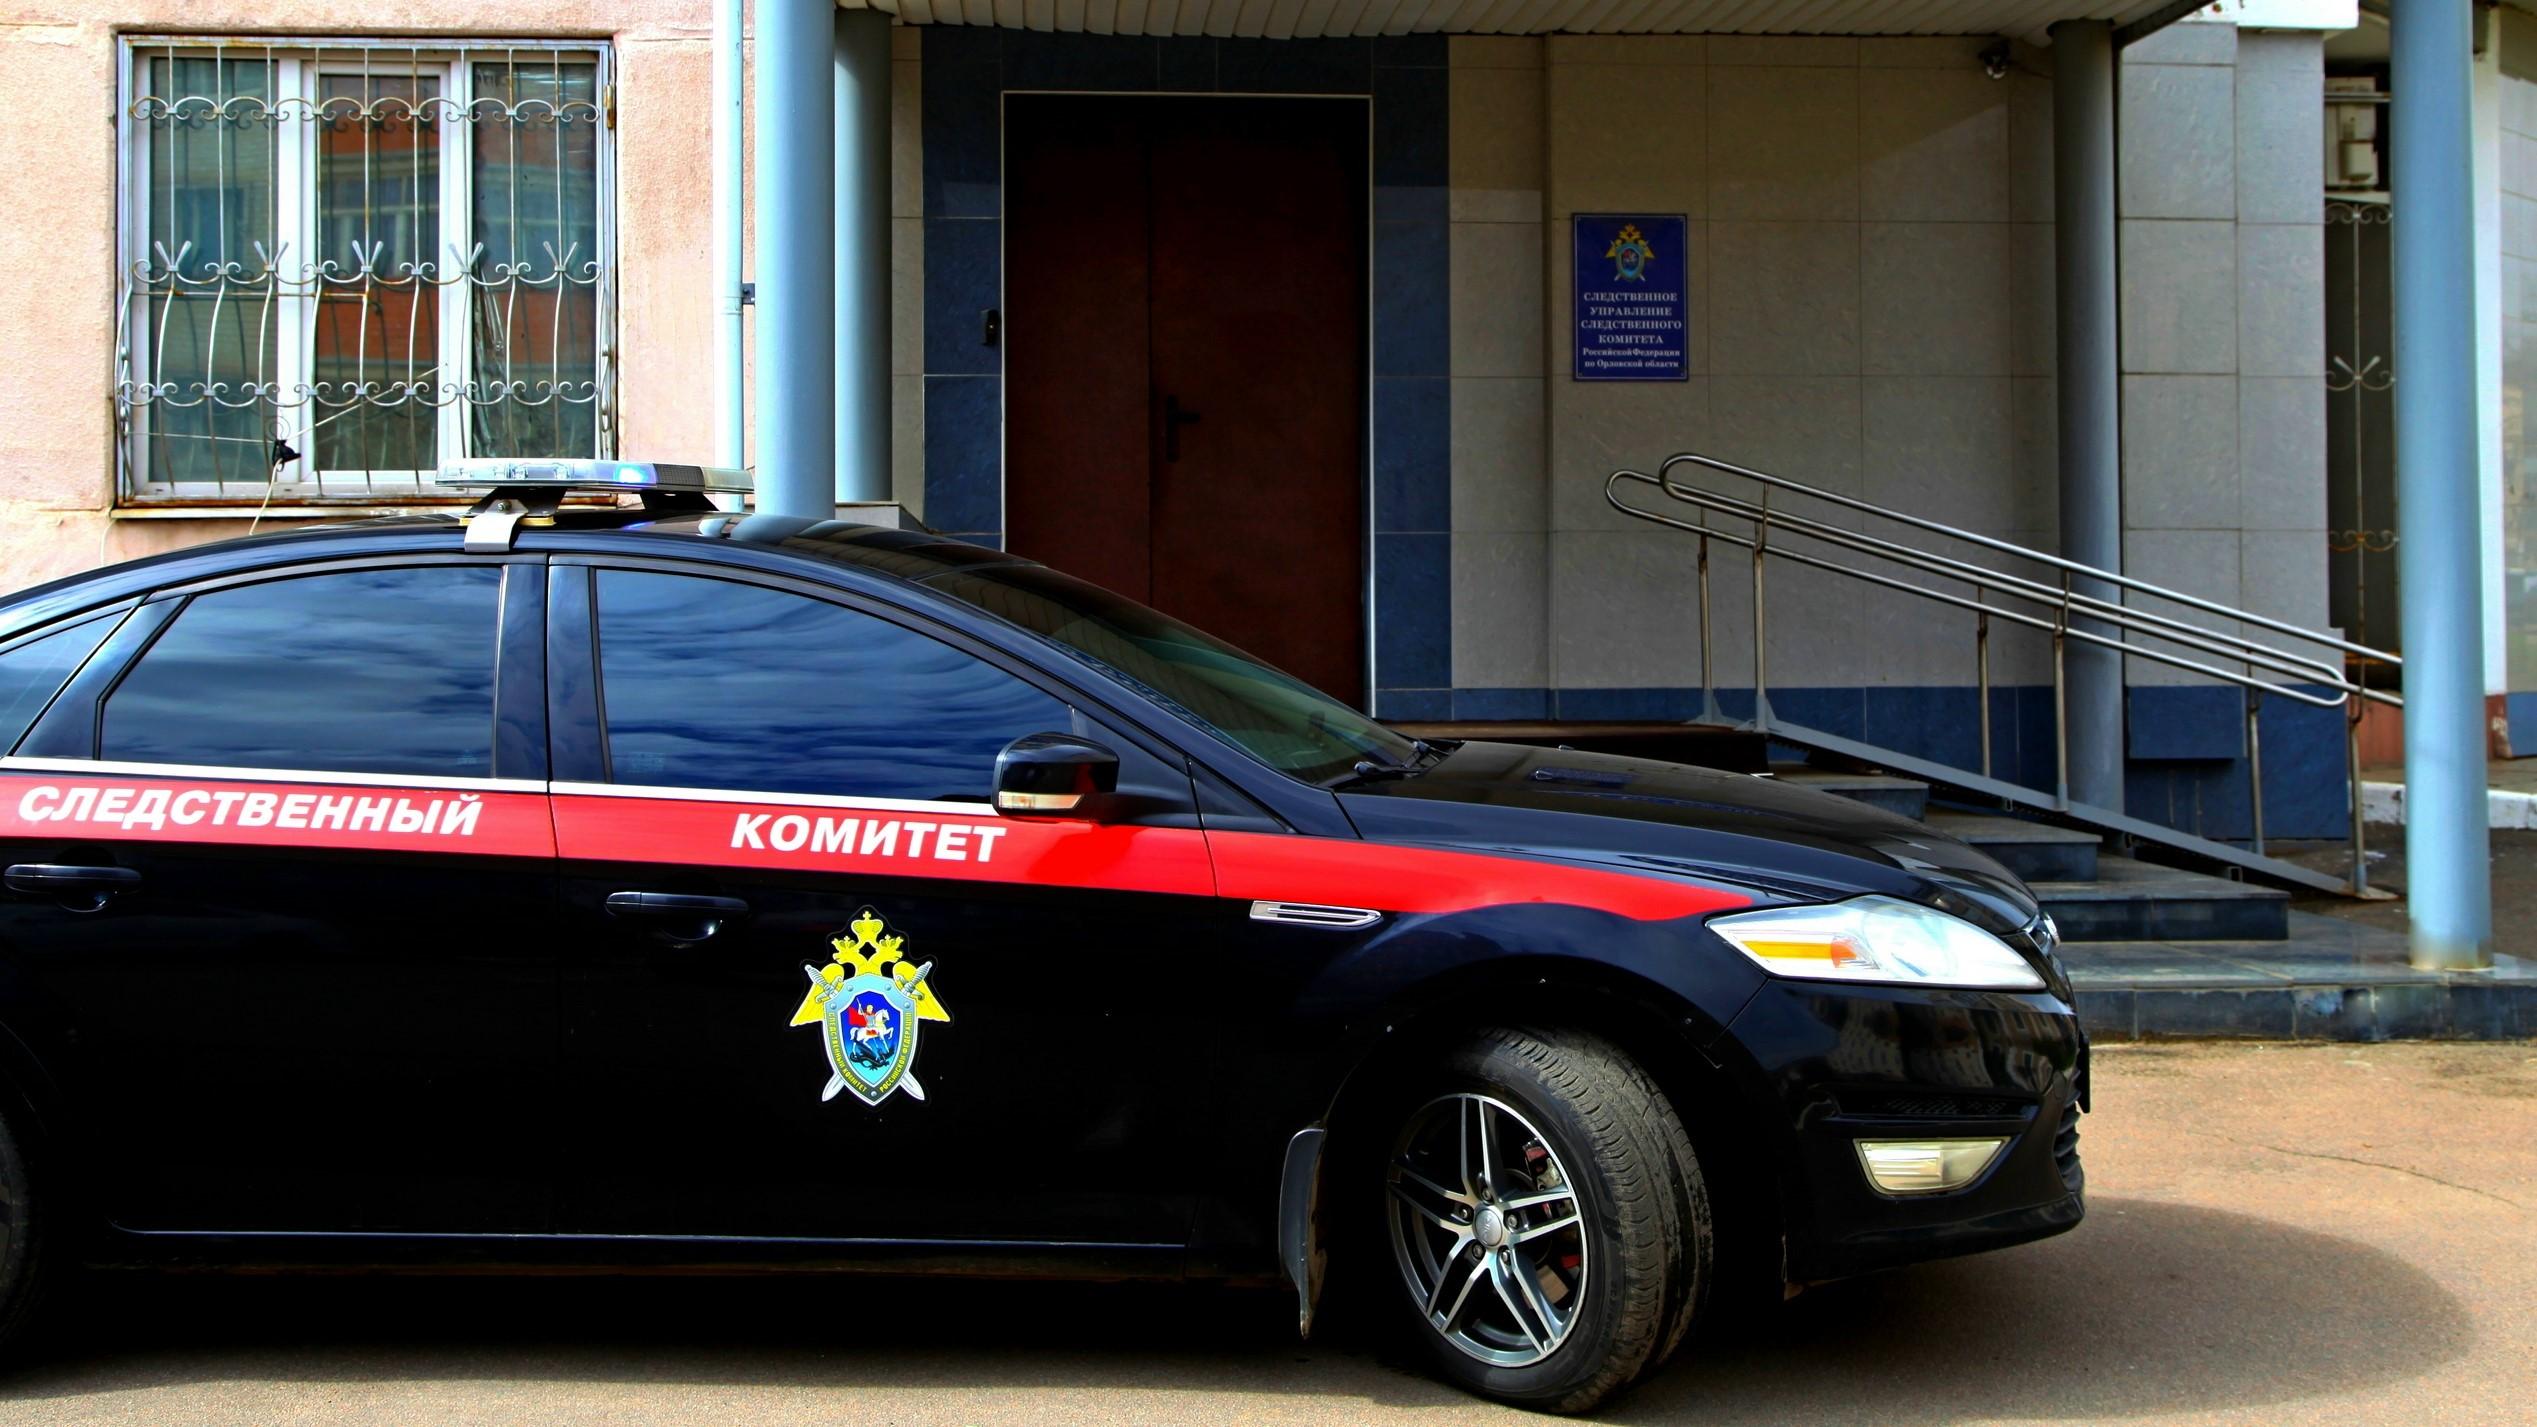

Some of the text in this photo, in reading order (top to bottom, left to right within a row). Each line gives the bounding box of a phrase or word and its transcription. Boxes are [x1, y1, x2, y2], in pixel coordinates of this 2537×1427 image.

[1583, 292, 1678, 303] СЛЕДСТВЕННОЕ
[1590, 306, 1672, 316] УПРАВЛЕНИЕ
[1581, 319, 1682, 330] СЛЕДСТВЕННОГО
[1598, 334, 1664, 344] КОМИТЕТА
[1583, 347, 1680, 358] Российской Федерации
[1597, 359, 1643, 369] Орловской
[1644, 359, 1679, 368] области
[18, 785, 1008, 863] СЛЕДСТВЕННЫЙ КОМИТЕТ
